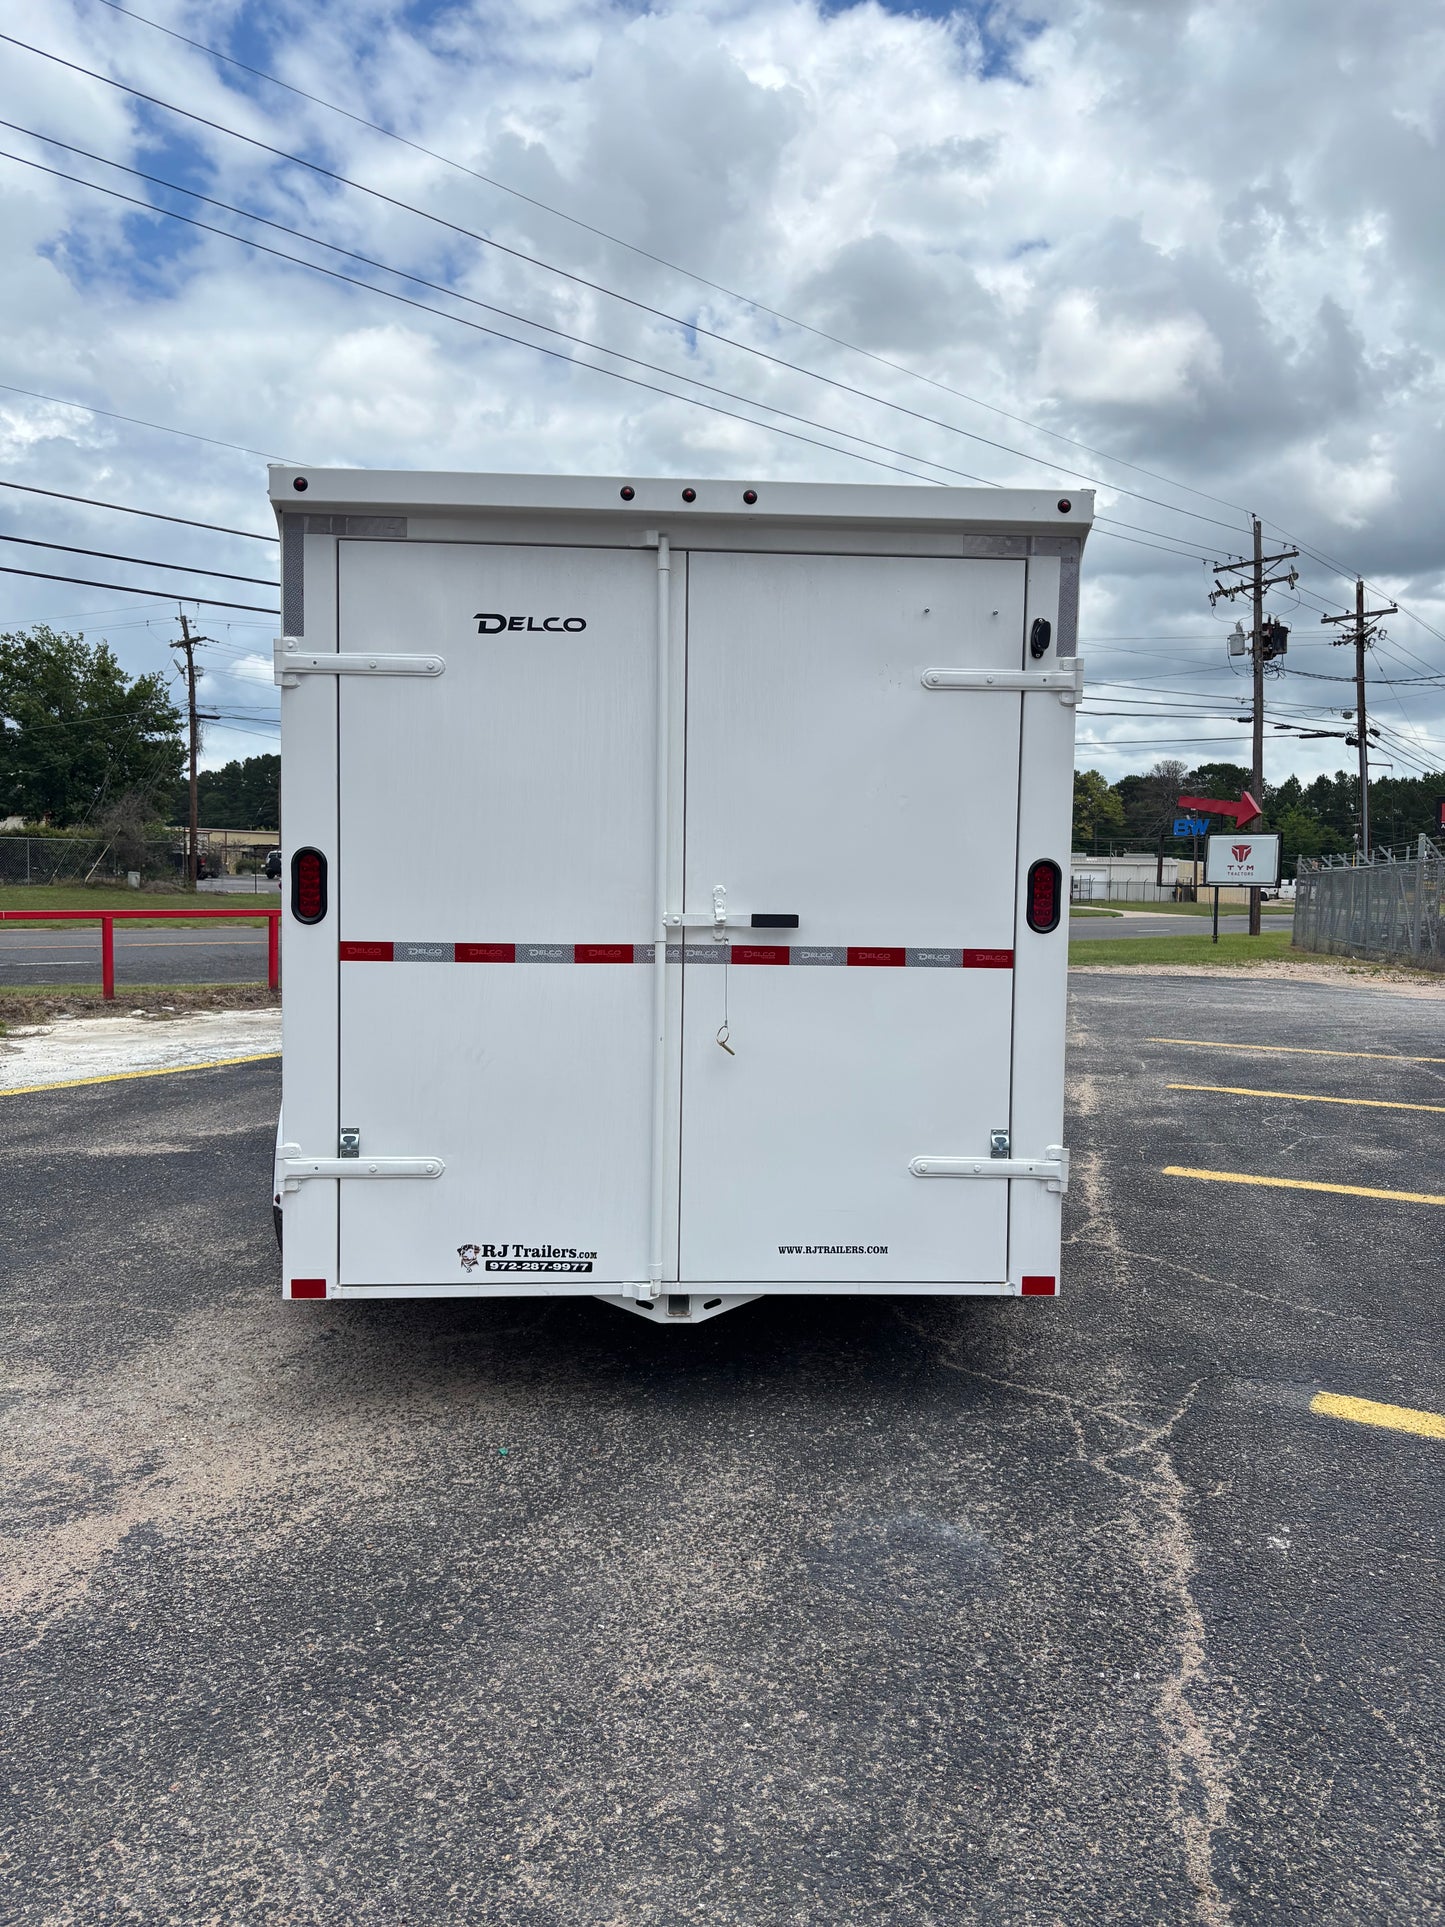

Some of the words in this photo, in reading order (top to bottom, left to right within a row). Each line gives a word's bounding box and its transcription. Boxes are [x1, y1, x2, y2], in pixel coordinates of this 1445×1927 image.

[473, 613, 587, 634] DELCO
[346, 947, 382, 955] DELCO
[408, 947, 442, 955] DELCO
[469, 948, 503, 956] DELCO
[529, 949, 562, 957] DELCO
[588, 949, 621, 957] DELCO
[743, 950, 776, 958] DELCO
[801, 951, 833, 959] DELCO
[858, 952, 890, 960] DELCO
[481, 1244, 509, 1258] RJ
[778, 1245, 888, 1254] WWW.RJTRAILERS.COM
[490, 1261, 588, 1272] 972-287-9977
